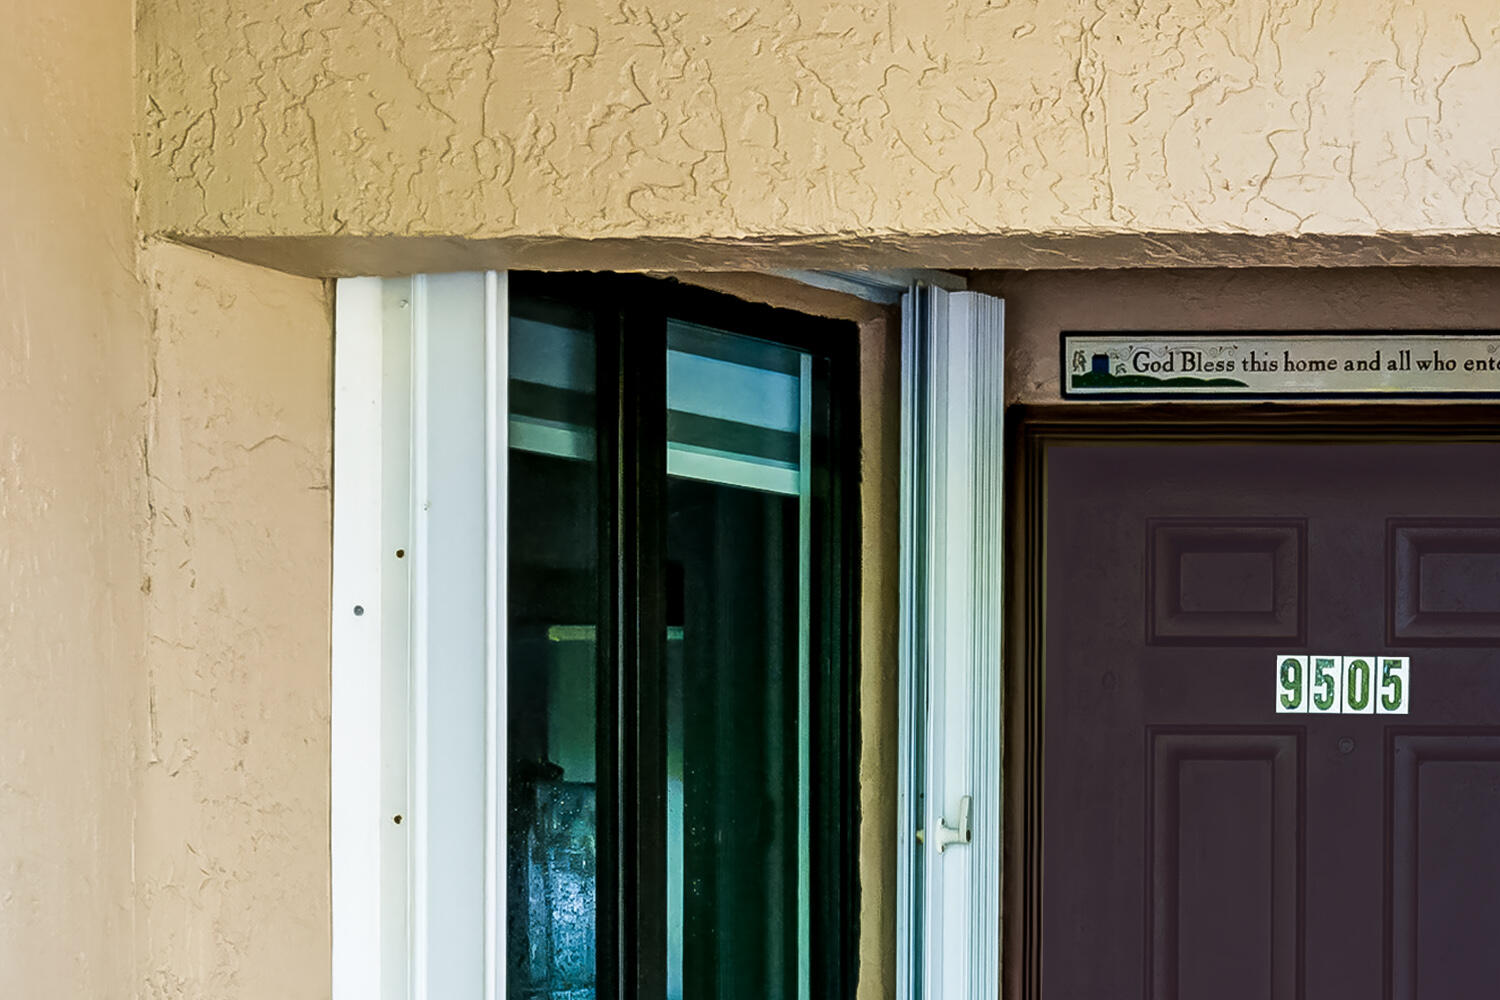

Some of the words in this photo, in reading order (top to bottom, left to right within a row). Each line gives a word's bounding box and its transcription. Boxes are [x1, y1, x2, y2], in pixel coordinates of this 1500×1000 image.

[1132, 350, 1174, 373] God
[1181, 350, 1235, 373] Bless
[1241, 350, 1278, 372] this
[1283, 350, 1337, 372] home
[1343, 350, 1381, 371] and
[1387, 350, 1411, 371] all
[1416, 350, 1457, 371] who
[1280, 658, 1403, 711] 9505
